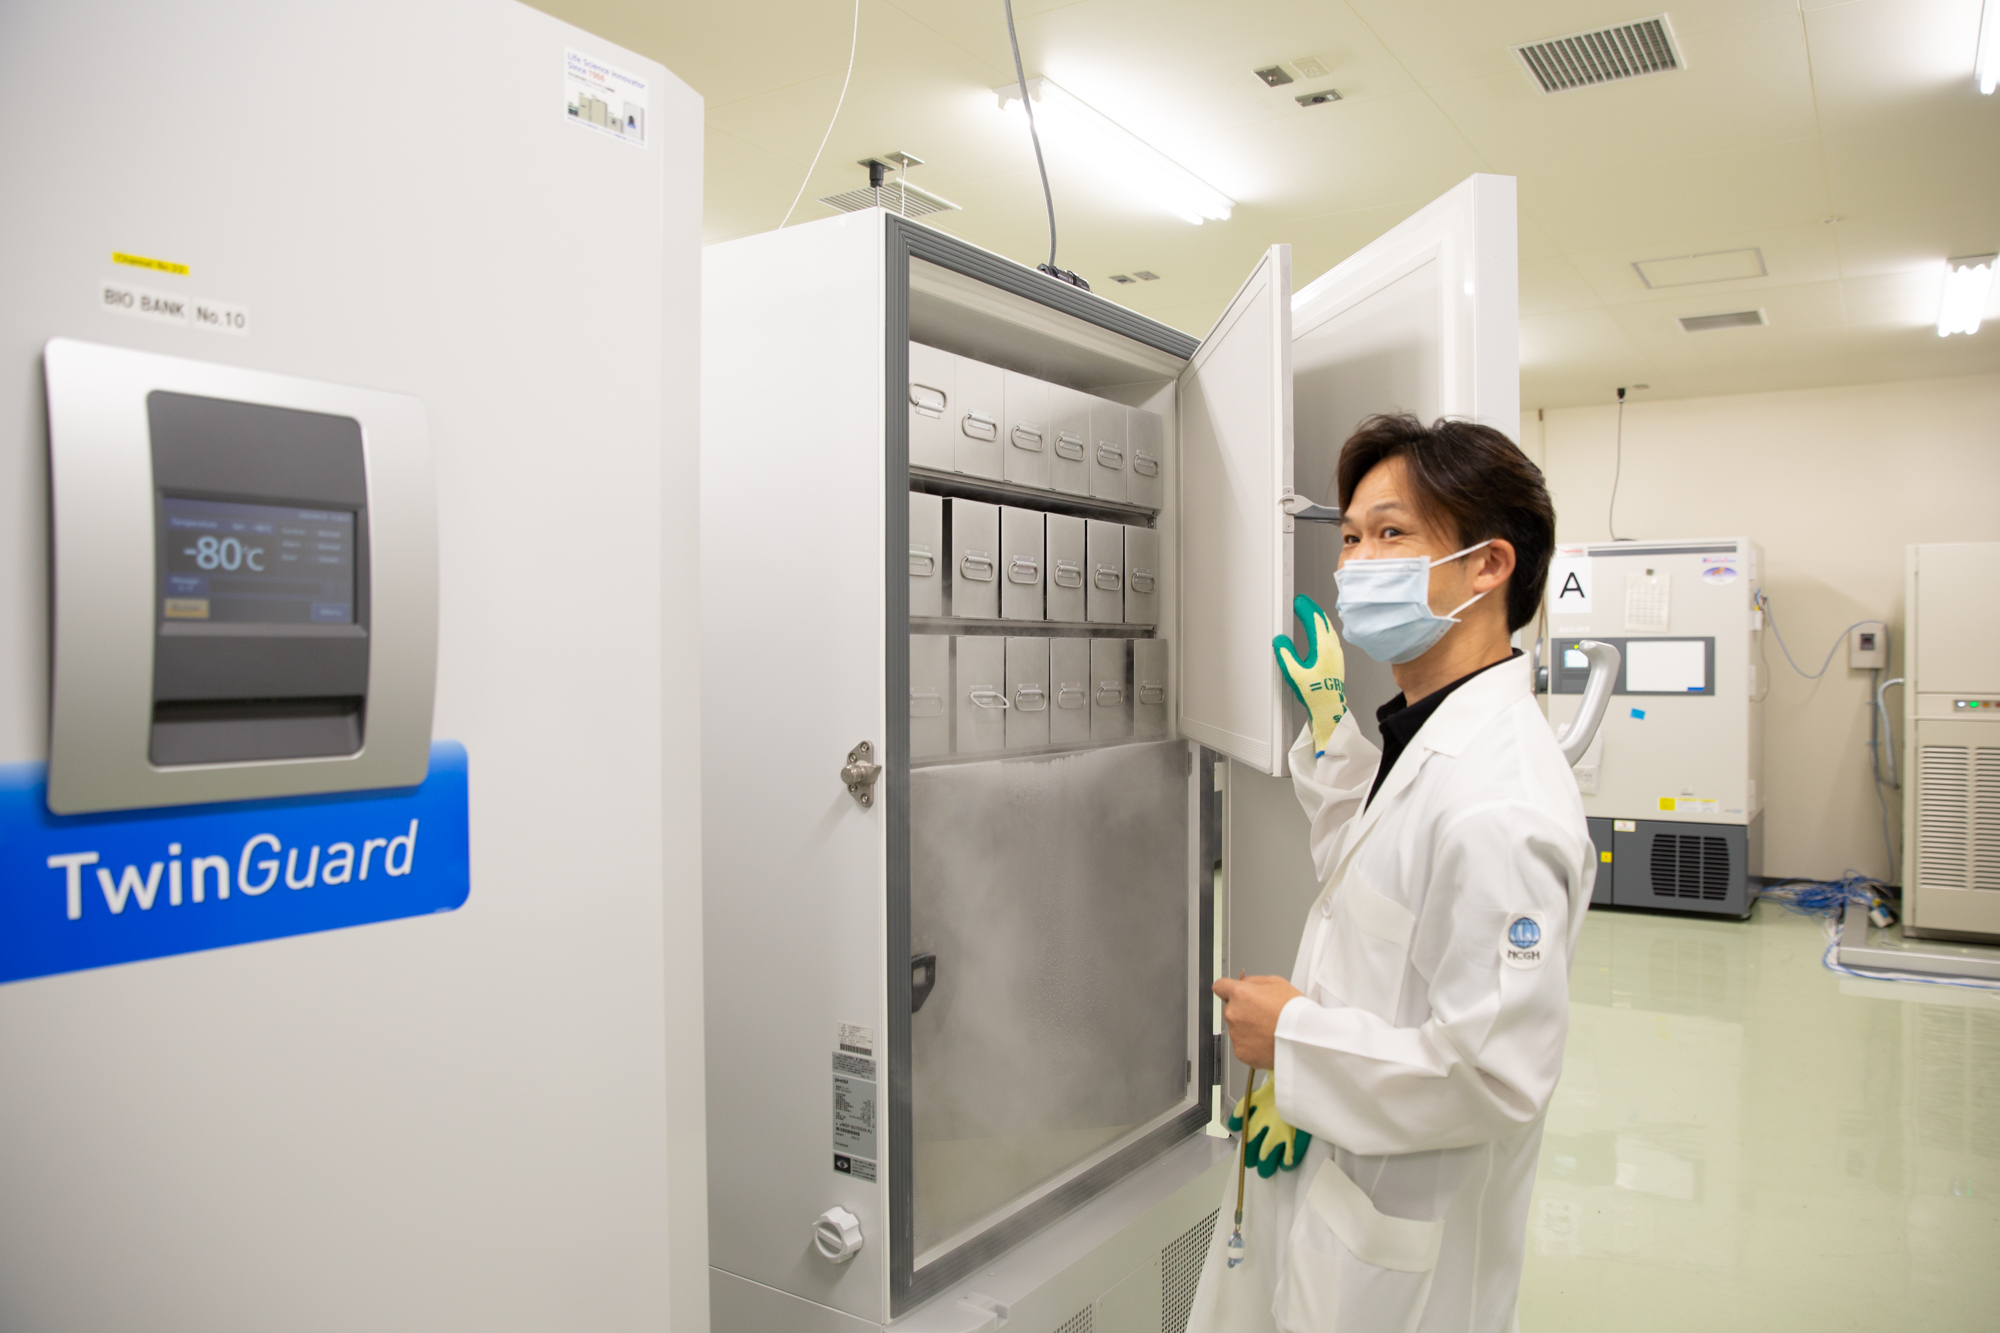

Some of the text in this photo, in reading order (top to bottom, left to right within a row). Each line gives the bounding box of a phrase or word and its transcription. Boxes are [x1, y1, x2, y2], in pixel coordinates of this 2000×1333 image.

[103, 288, 246, 329] BIO BANK No.10
[1559, 572, 1585, 598] A
[46, 818, 419, 921] TwinGuard
